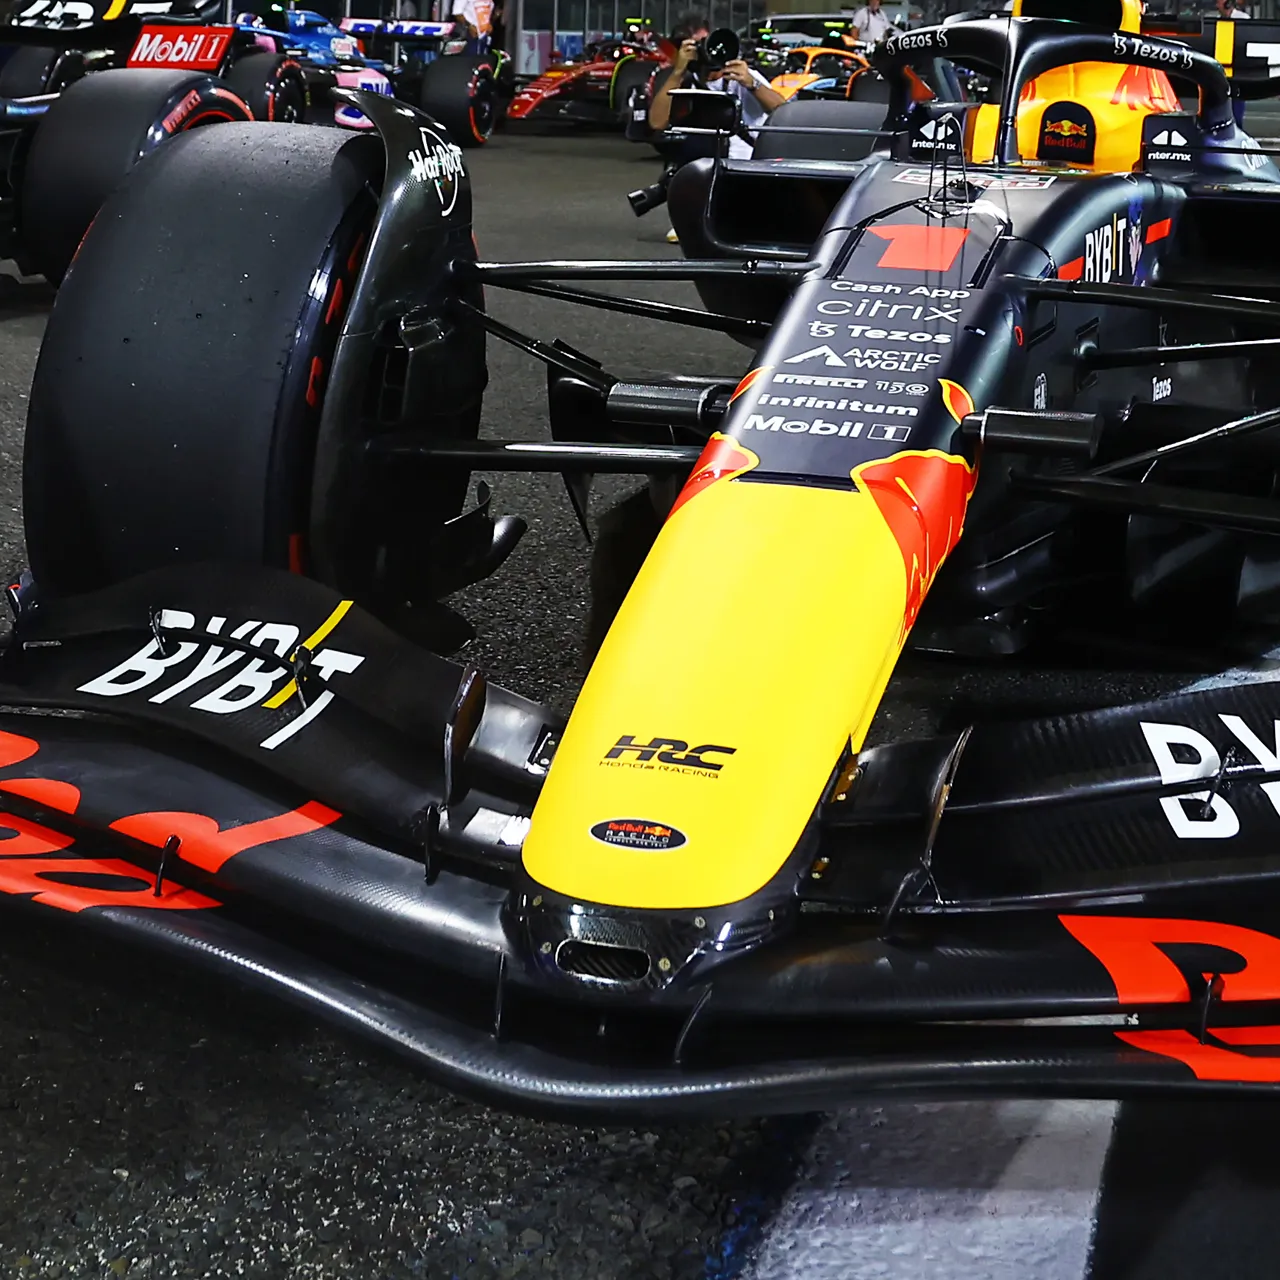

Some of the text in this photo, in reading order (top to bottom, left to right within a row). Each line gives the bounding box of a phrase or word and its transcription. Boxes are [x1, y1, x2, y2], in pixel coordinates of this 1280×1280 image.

[131, 33, 204, 63] Mobil
[1131, 38, 1178, 64] Tezos
[1148, 151, 1191, 162] nter.mx
[864, 224, 971, 272] 1
[1085, 213, 1127, 283] BYBIT
[831, 280, 971, 300] Cash App
[816, 299, 963, 323] citrix
[847, 324, 952, 345] Tezos
[843, 347, 942, 364] ARCTIC
[854, 357, 930, 373] WOLF
[772, 373, 868, 389] PIRELLI
[1152, 376, 1172, 402] Tezos
[758, 394, 919, 417] infinitum
[743, 414, 864, 439] Mobil
[76, 600, 365, 750] BYBIT
[604, 735, 738, 771] HRC
[599, 760, 720, 780] Honda RACING
